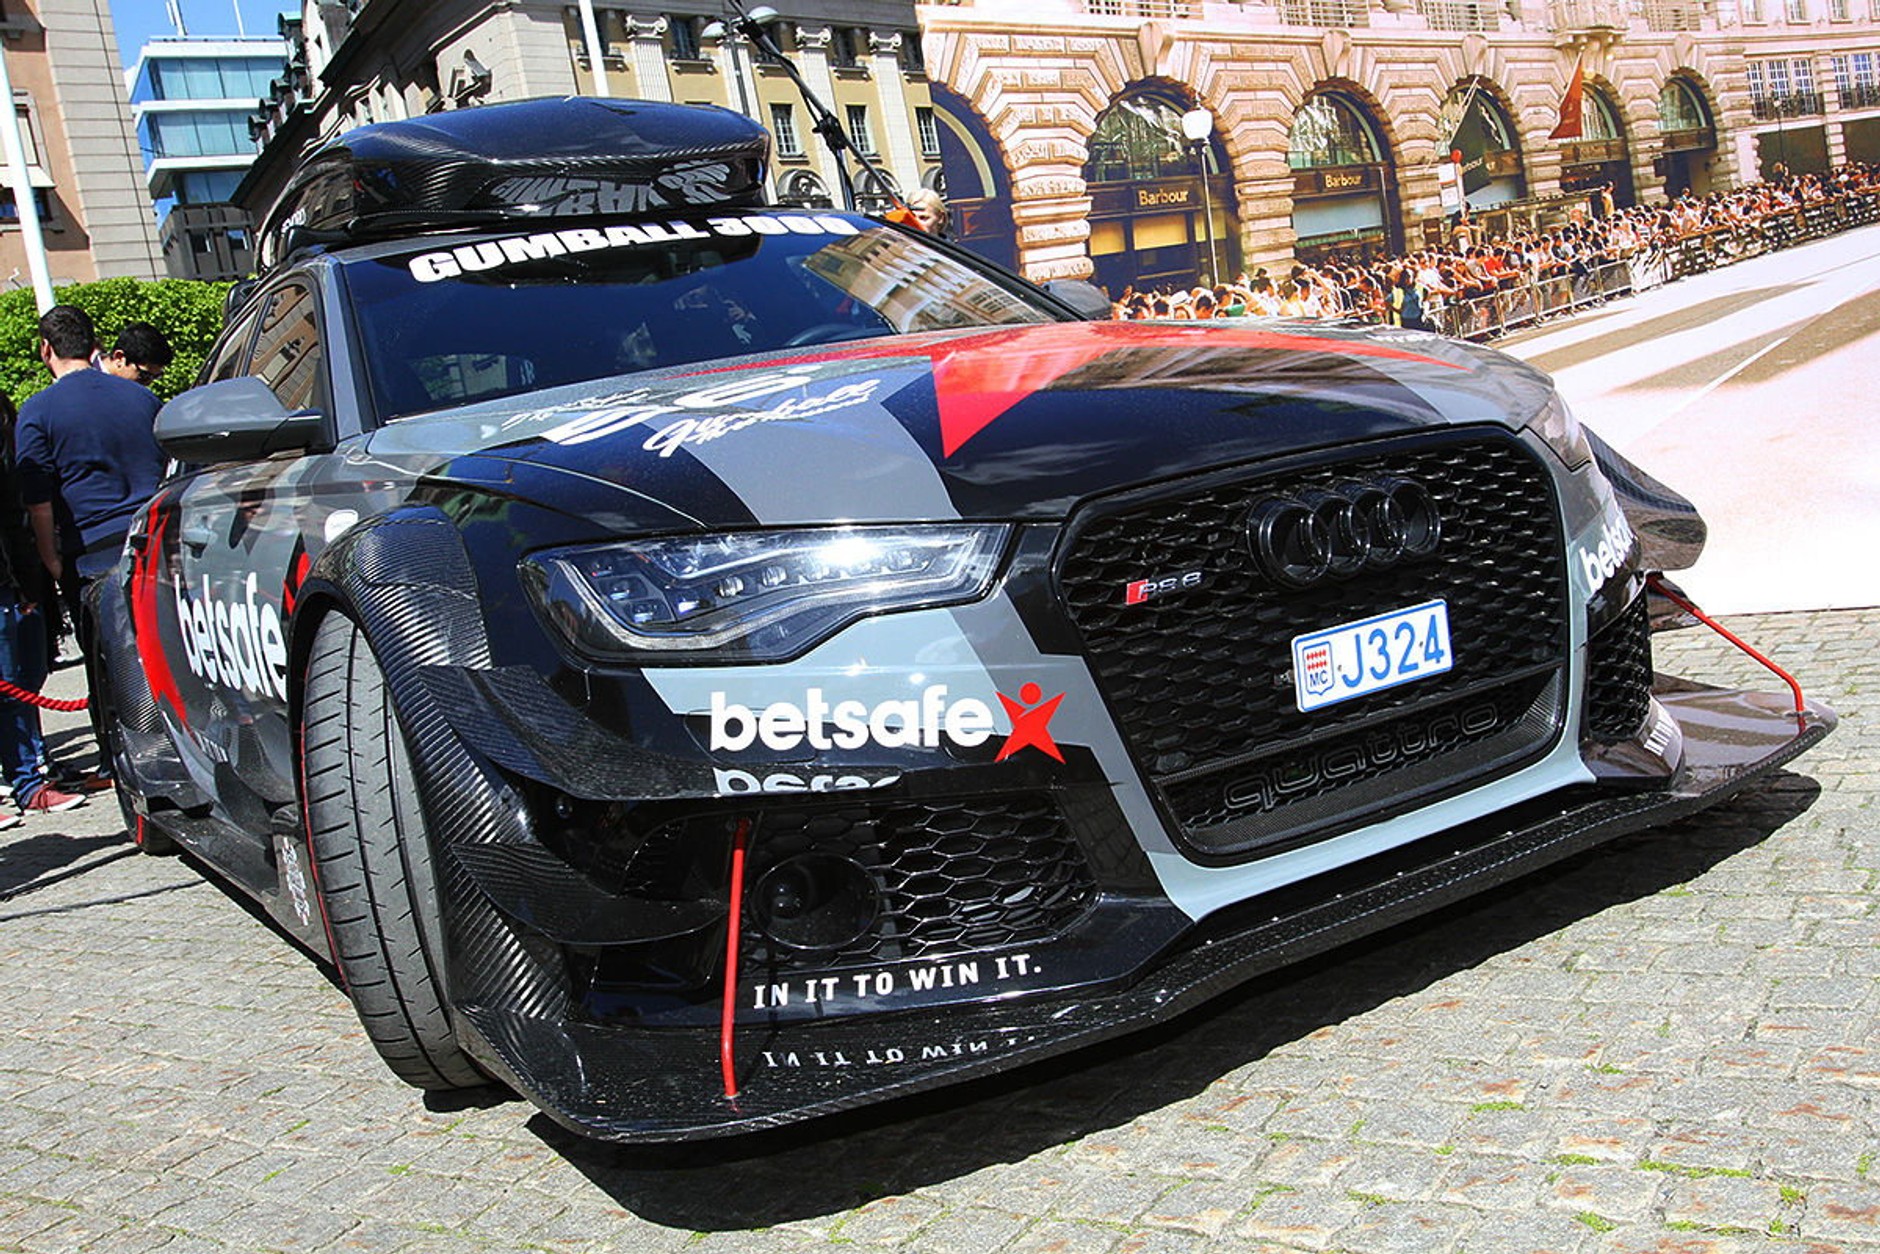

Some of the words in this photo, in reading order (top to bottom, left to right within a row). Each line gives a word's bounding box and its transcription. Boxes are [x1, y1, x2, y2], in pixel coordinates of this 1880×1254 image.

[1138, 188, 1188, 206] Barbour
[1325, 173, 1361, 188] Barbour
[408, 218, 711, 283] GUMBALL
[706, 215, 860, 236] 3000
[173, 571, 288, 702] betsafe
[1309, 670, 1329, 688] MC
[1340, 613, 1446, 689] J324
[709, 683, 994, 752] betsafe
[1224, 702, 1498, 812] quattro
[753, 982, 790, 1010] IN
[805, 977, 840, 1004] IT
[853, 971, 894, 998] TO
[909, 961, 979, 992] WIN
[995, 953, 1043, 980] IT.
